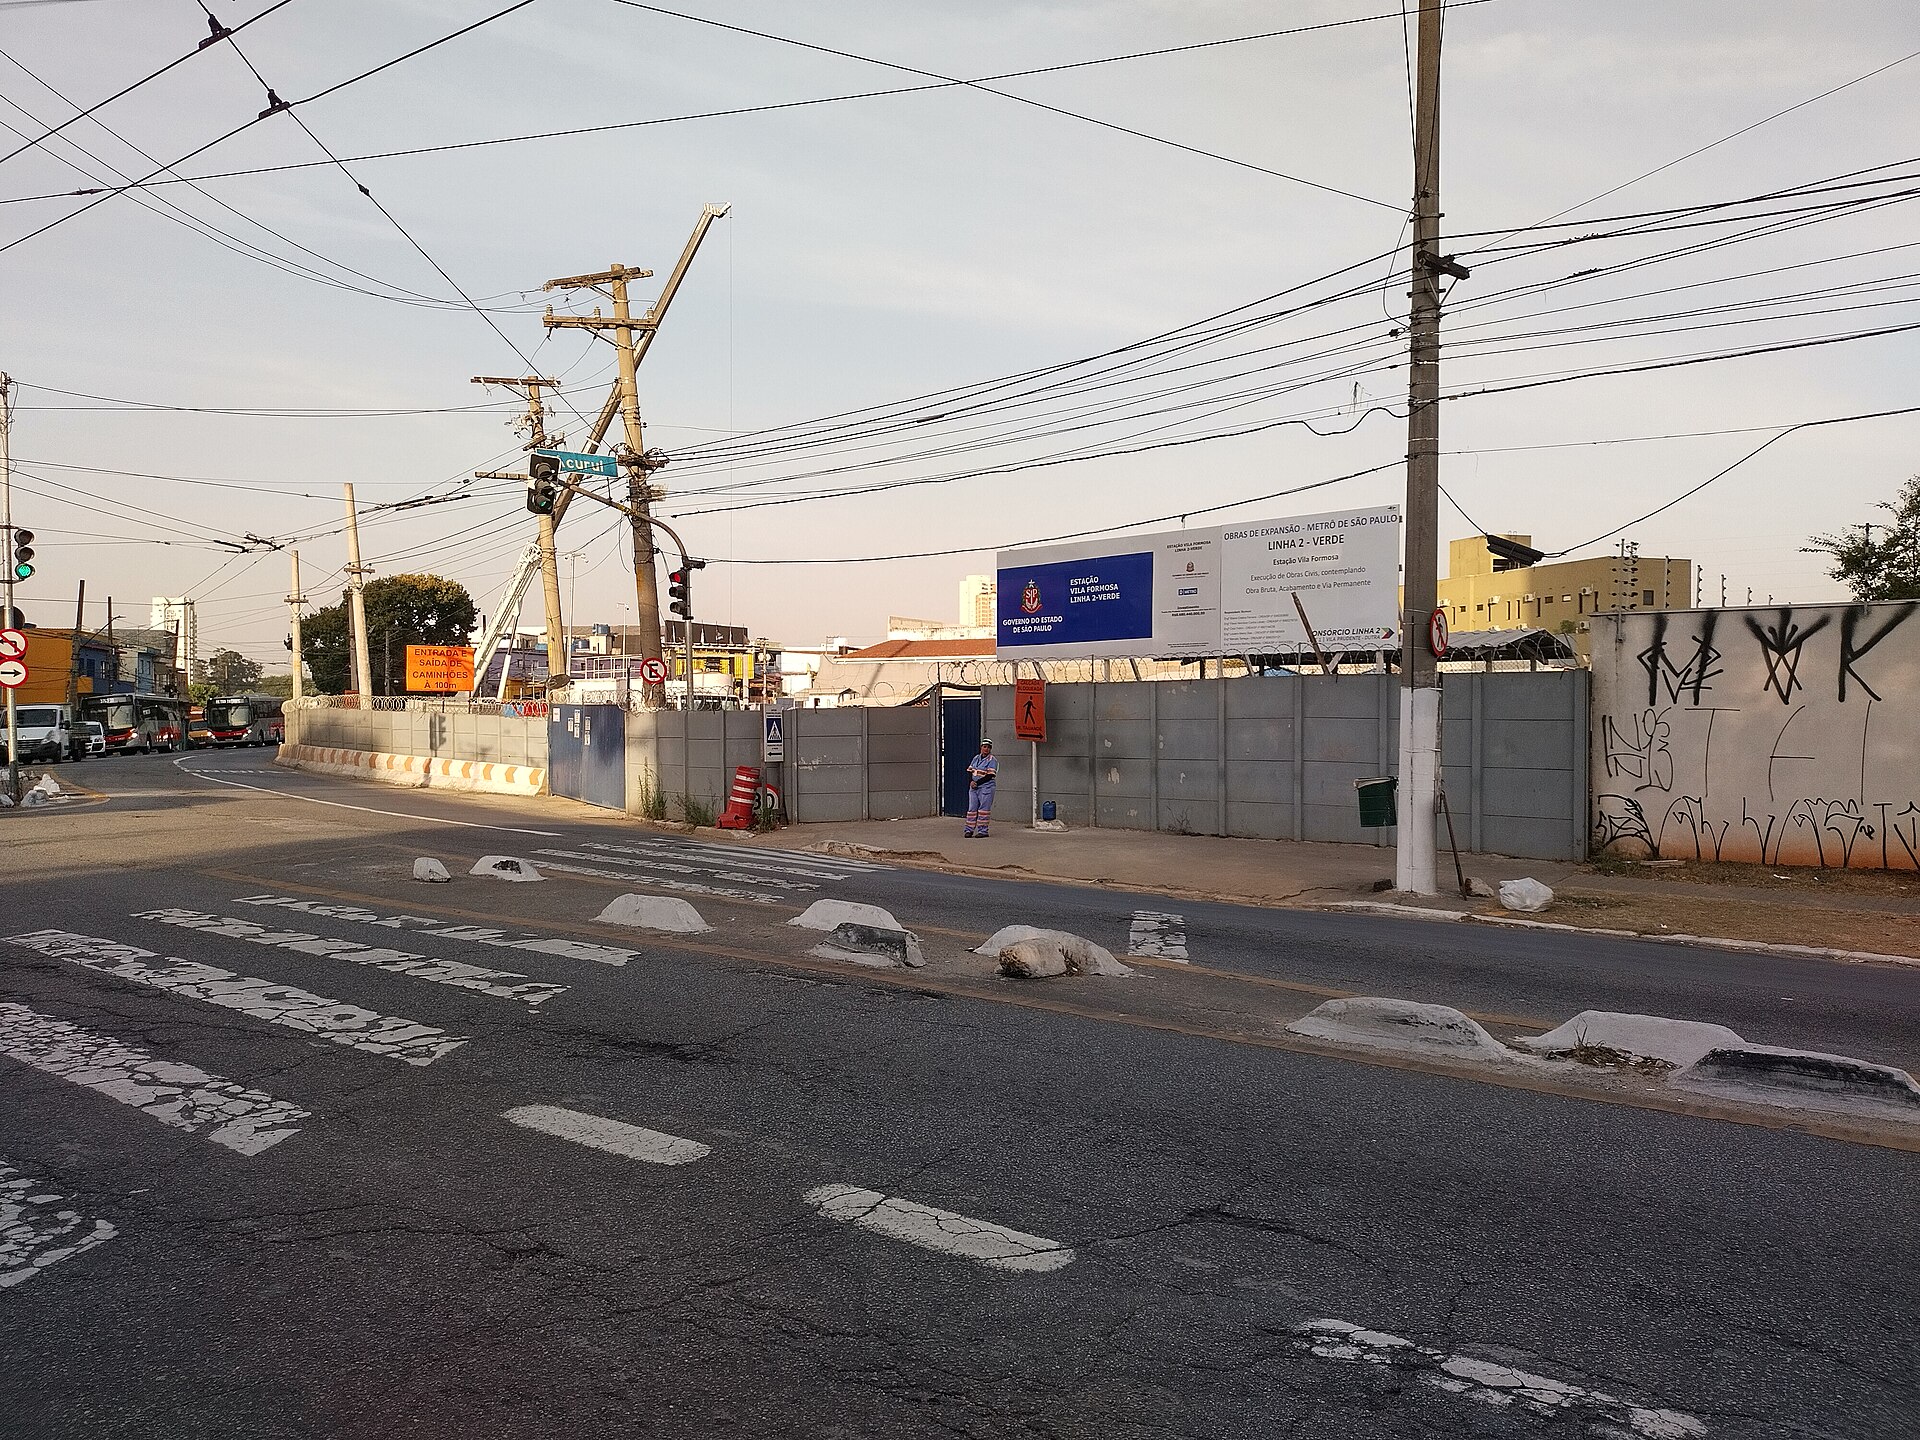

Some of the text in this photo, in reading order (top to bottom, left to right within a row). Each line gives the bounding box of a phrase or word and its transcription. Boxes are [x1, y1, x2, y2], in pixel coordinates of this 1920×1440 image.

[1224, 531, 1248, 540] OBRAS
[1249, 529, 1259, 538] DE
[1260, 524, 1300, 537] EXPANSÃO
[1307, 520, 1336, 532] METRÔ
[1338, 519, 1349, 529] DE
[1350, 516, 1368, 527] SÃO
[1369, 514, 1398, 525] PAULO
[1268, 539, 1296, 551] LINHA
[1298, 538, 1305, 548] 2
[1312, 534, 1345, 547] VERDE
[1273, 553, 1339, 566] Estação Vila Formosa
[1250, 572, 1277, 582] Execução
[1277, 571, 1286, 580] de
[1286, 569, 1303, 579] Obras
[1321, 566, 1366, 577] contemplando
[1070, 575, 1099, 586] ESTAÇÃO
[1070, 583, 1119, 595] VILA FORMOSA
[1245, 586, 1260, 595] Obra
[1278, 583, 1316, 593] Acabamento
[1322, 581, 1332, 589] Via
[1333, 579, 1371, 588] Permanente
[1070, 594, 1091, 604] LINHA
[1003, 615, 1063, 626] GOVERNO DO ESTADO
[1013, 624, 1053, 634] DE SÃO PAULO
[1312, 628, 1350, 637] ONSÓRCIO
[1352, 627, 1374, 635] LINHA
[414, 648, 459, 657] ENTRADA
[419, 657, 447, 667] SAÍDA
[412, 669, 468, 679] CAMINHÕES
